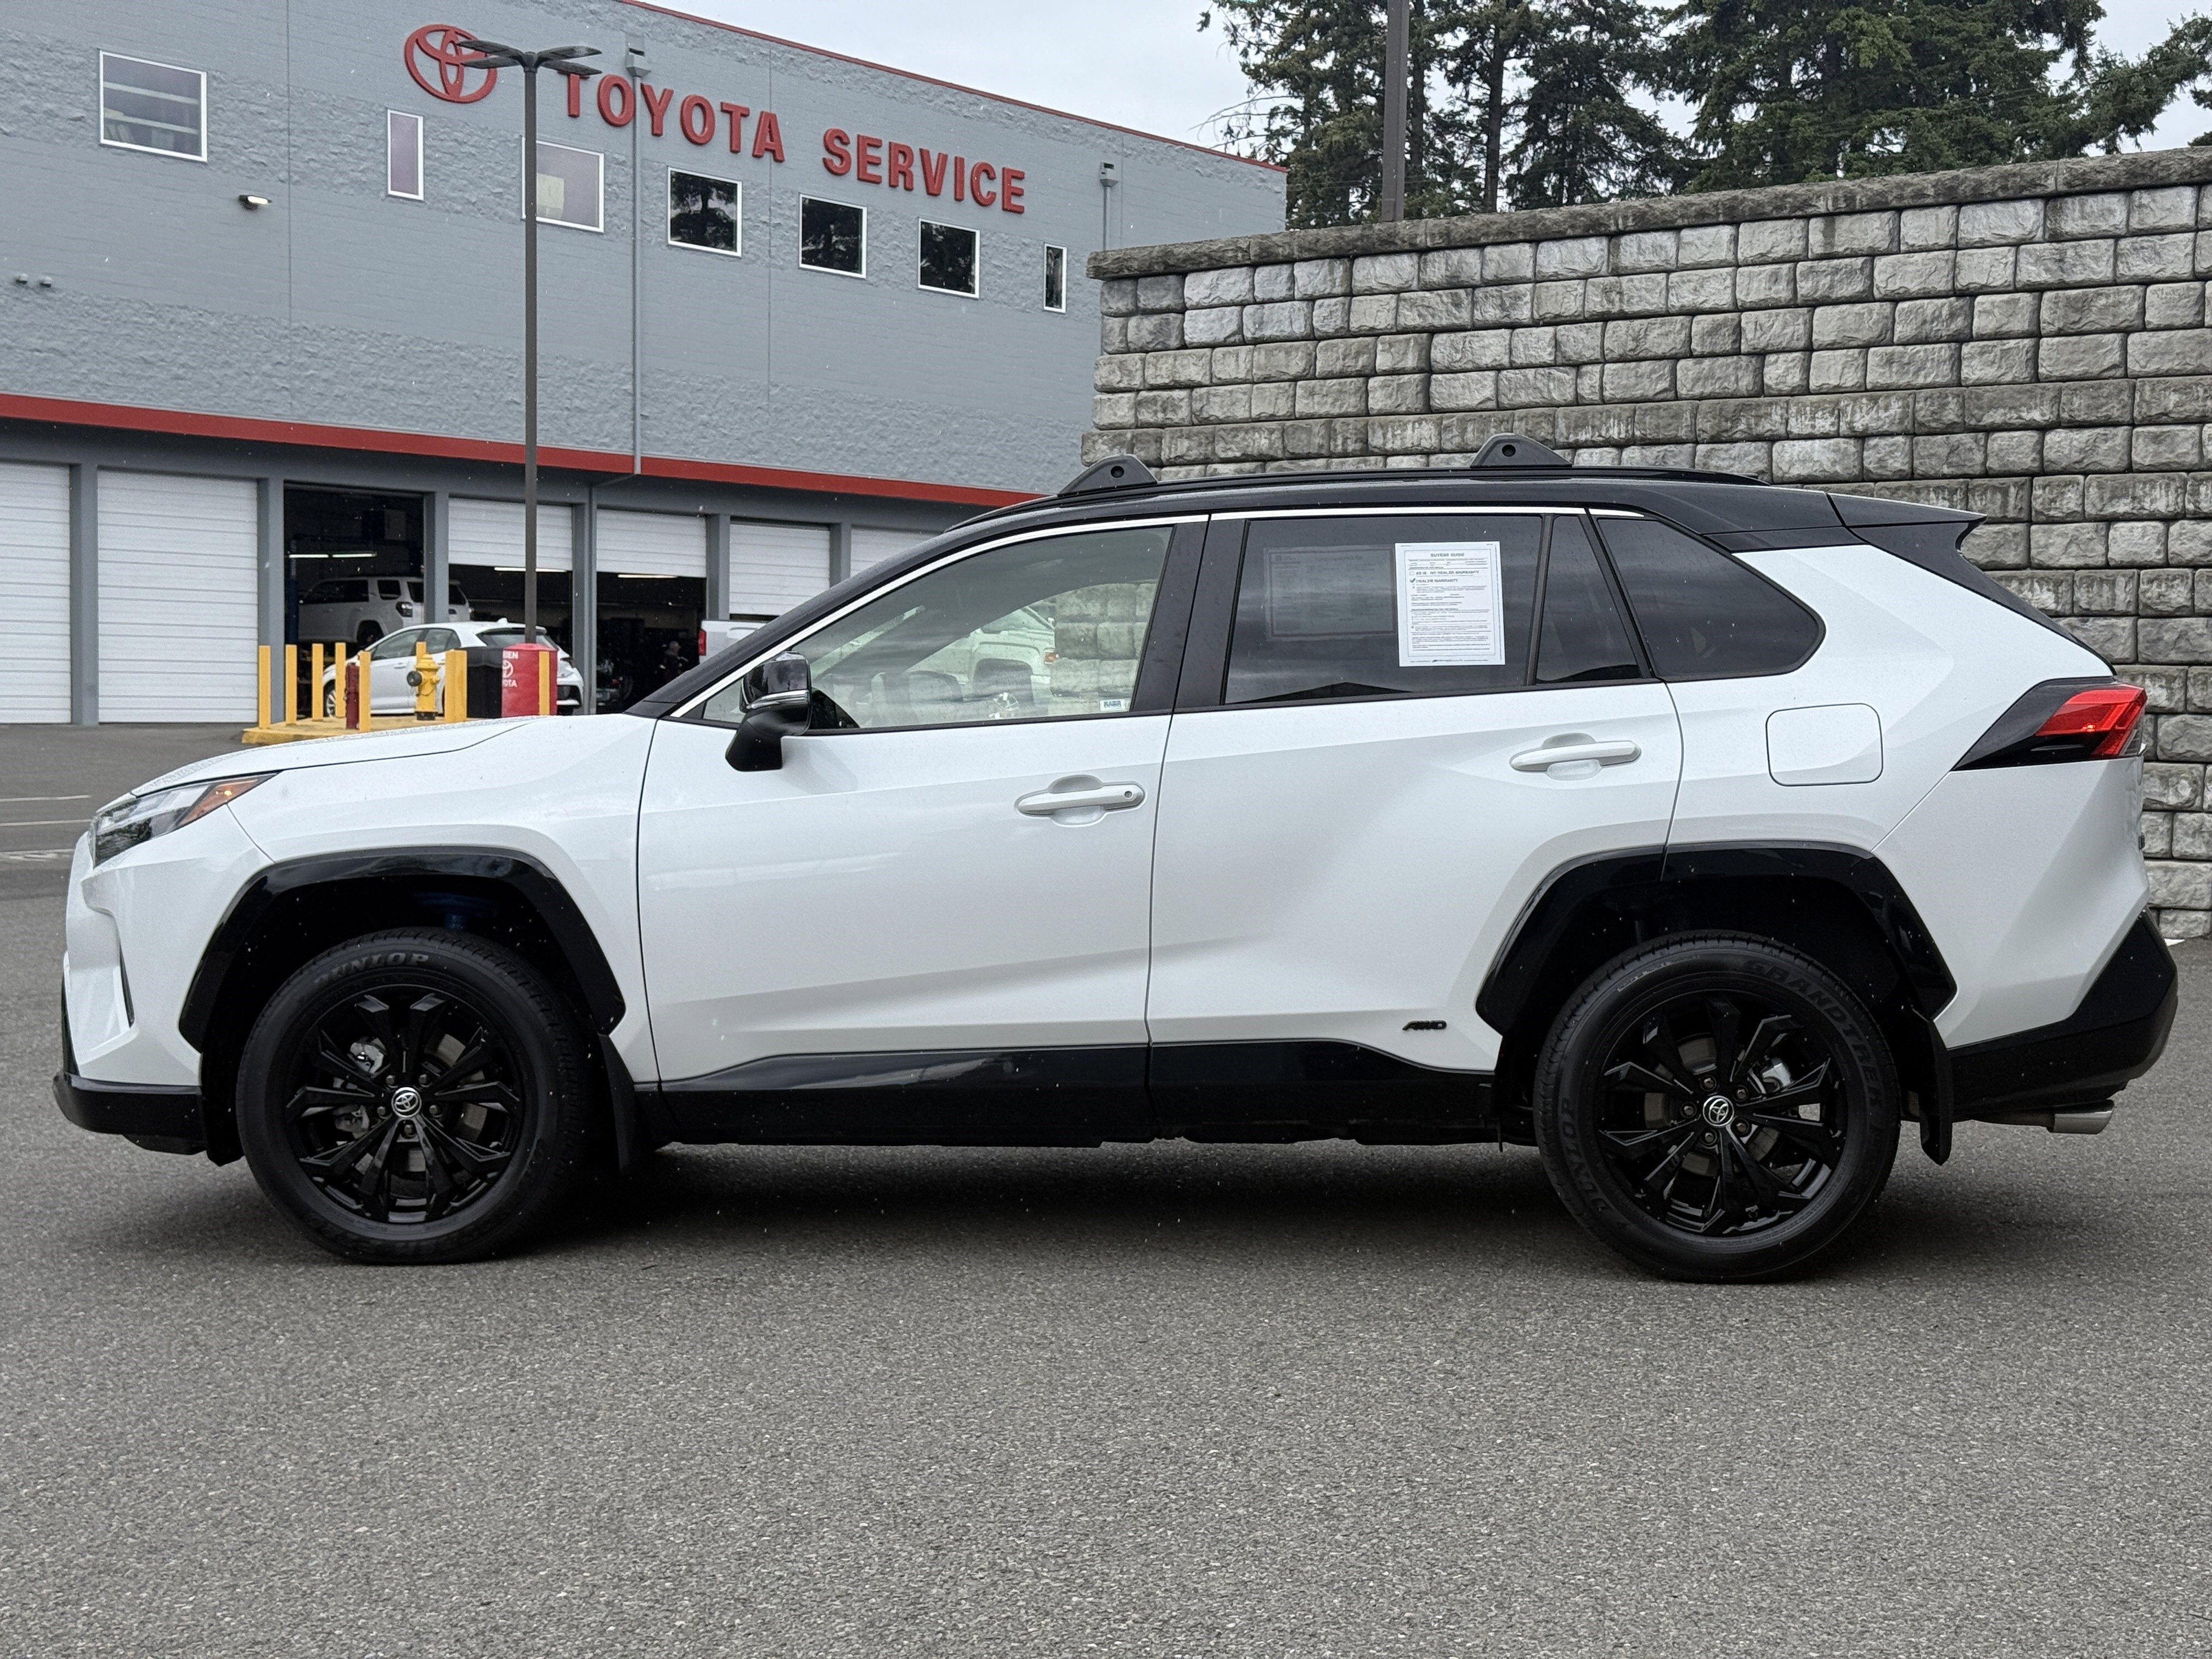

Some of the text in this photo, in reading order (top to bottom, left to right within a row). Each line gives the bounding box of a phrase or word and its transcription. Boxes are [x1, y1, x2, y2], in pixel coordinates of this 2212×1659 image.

[558, 71, 1025, 214] TOYOTA SERVICE
[502, 679, 517, 687] OTA
[314, 952, 429, 984] DUNLOP
[1560, 1097, 1610, 1211] DUNLOP
